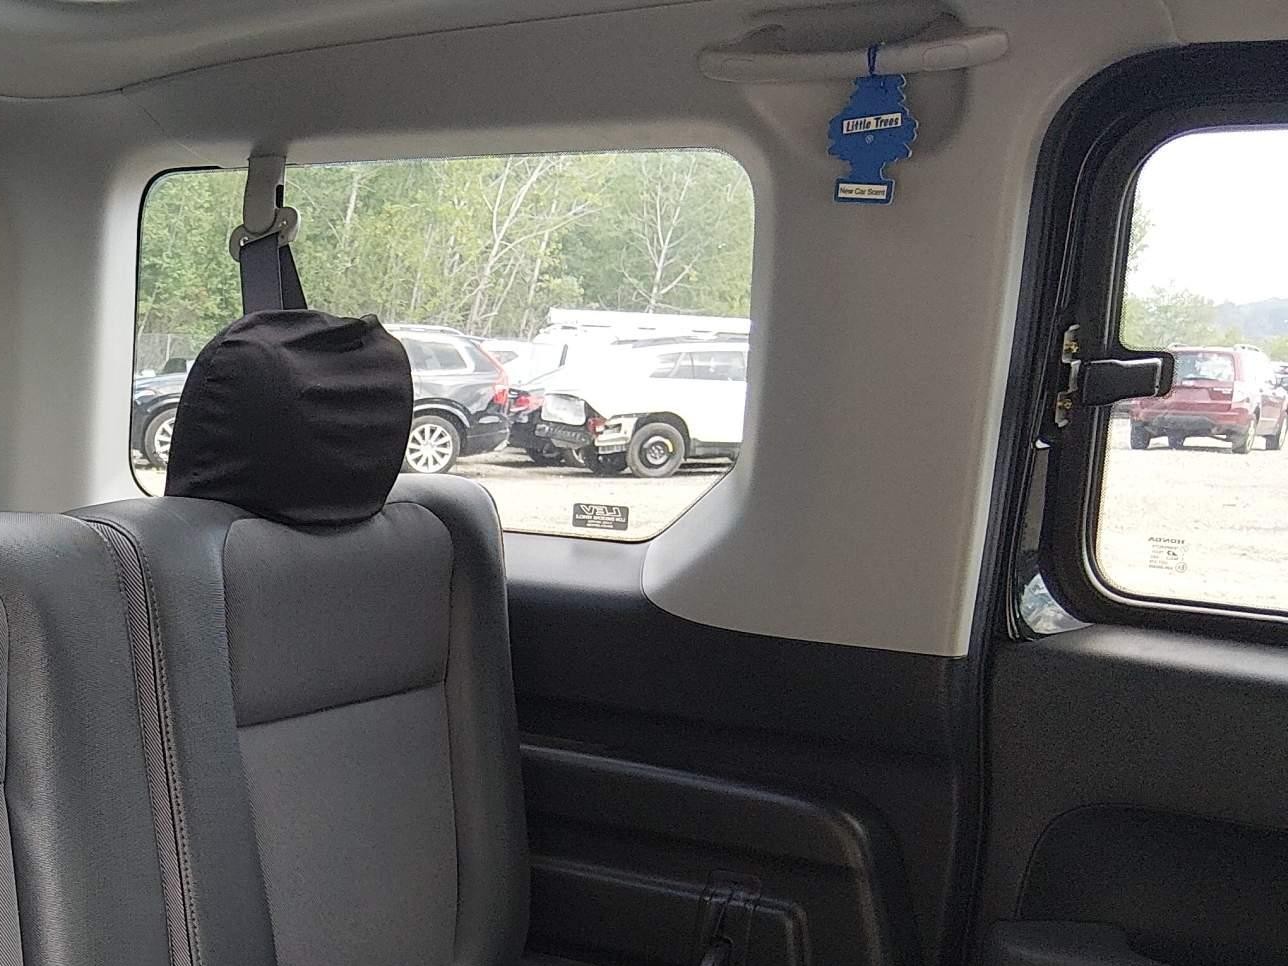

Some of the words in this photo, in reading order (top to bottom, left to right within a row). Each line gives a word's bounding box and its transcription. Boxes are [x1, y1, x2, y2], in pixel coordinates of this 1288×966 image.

[846, 118, 872, 132] Little
[874, 116, 900, 128] Trees
[840, 186, 854, 195] New
[855, 187, 866, 196] Car
[867, 188, 886, 196] Scent
